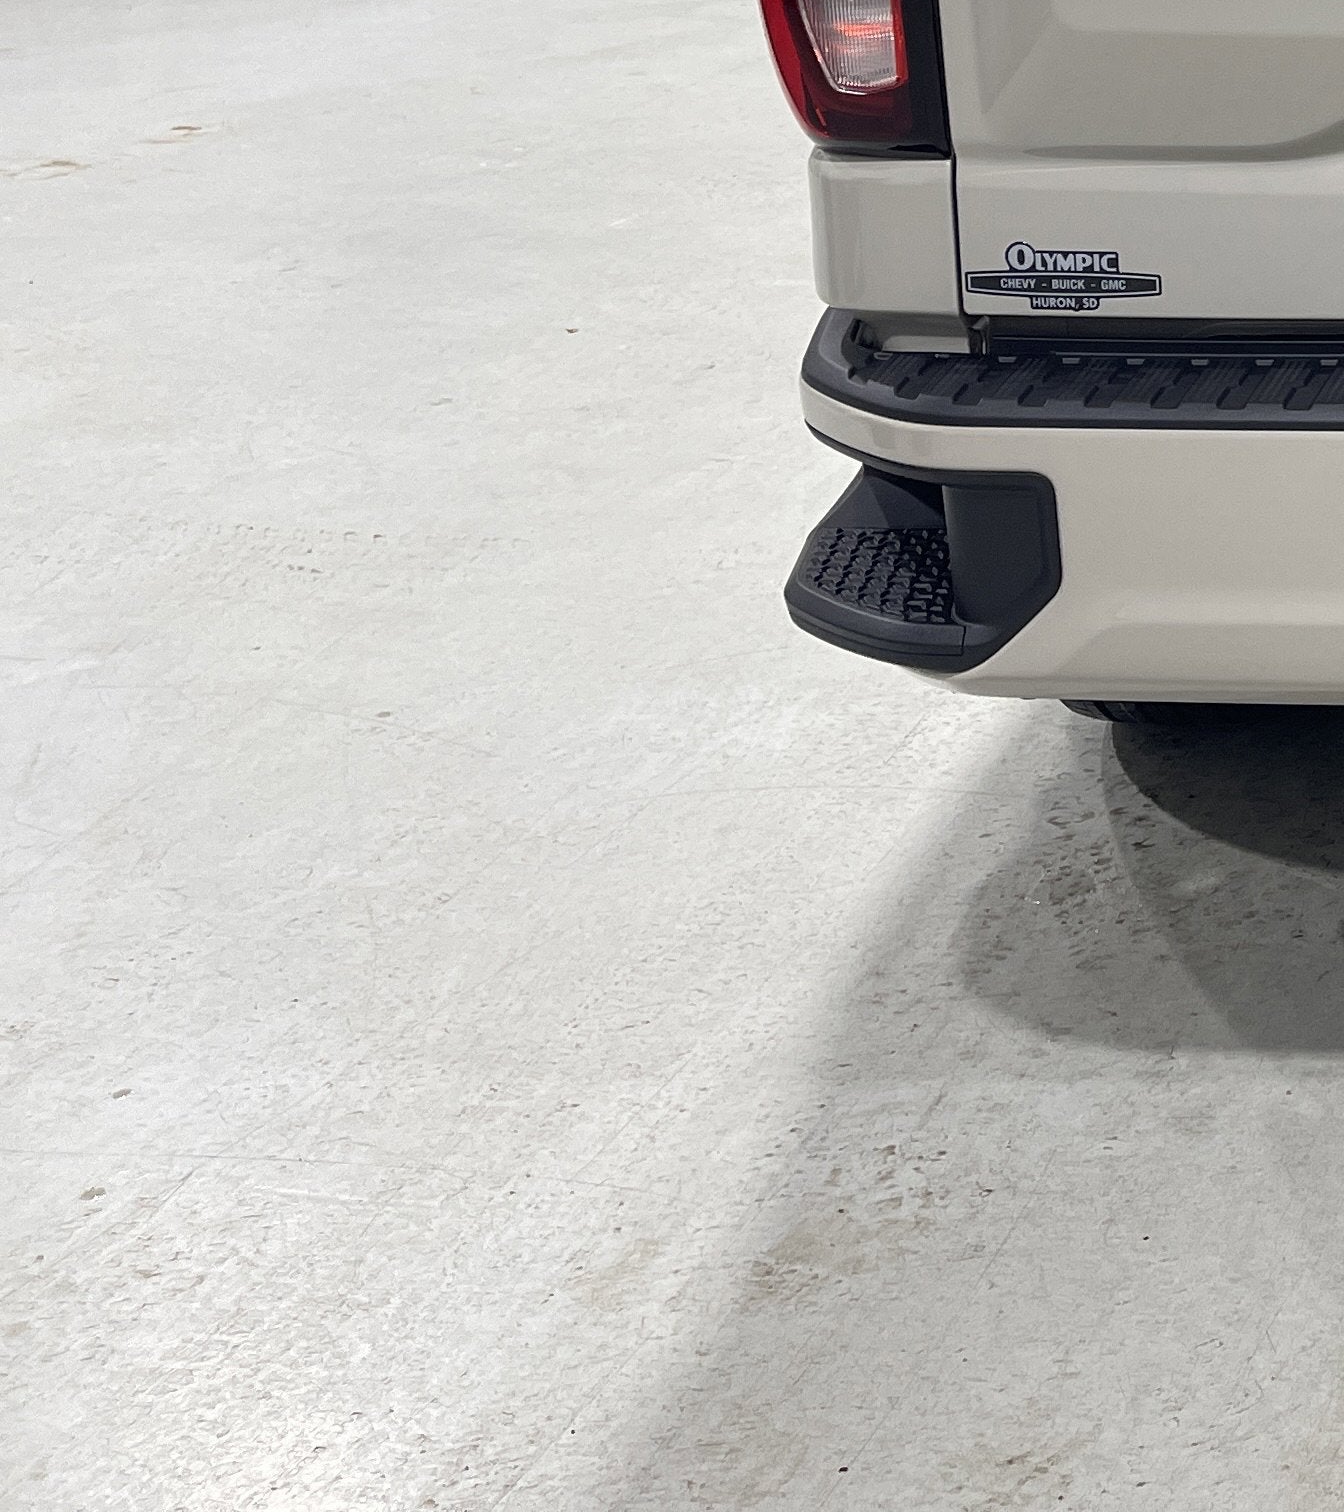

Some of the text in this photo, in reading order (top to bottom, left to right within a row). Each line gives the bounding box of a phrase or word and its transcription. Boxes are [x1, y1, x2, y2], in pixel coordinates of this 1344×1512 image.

[1007, 243, 1118, 272] OLYMPIC
[1000, 278, 1036, 289] CHEVY
[1051, 279, 1085, 290] BUICK
[1101, 279, 1127, 291] GMC
[1032, 296, 1098, 310] HURON, SD
